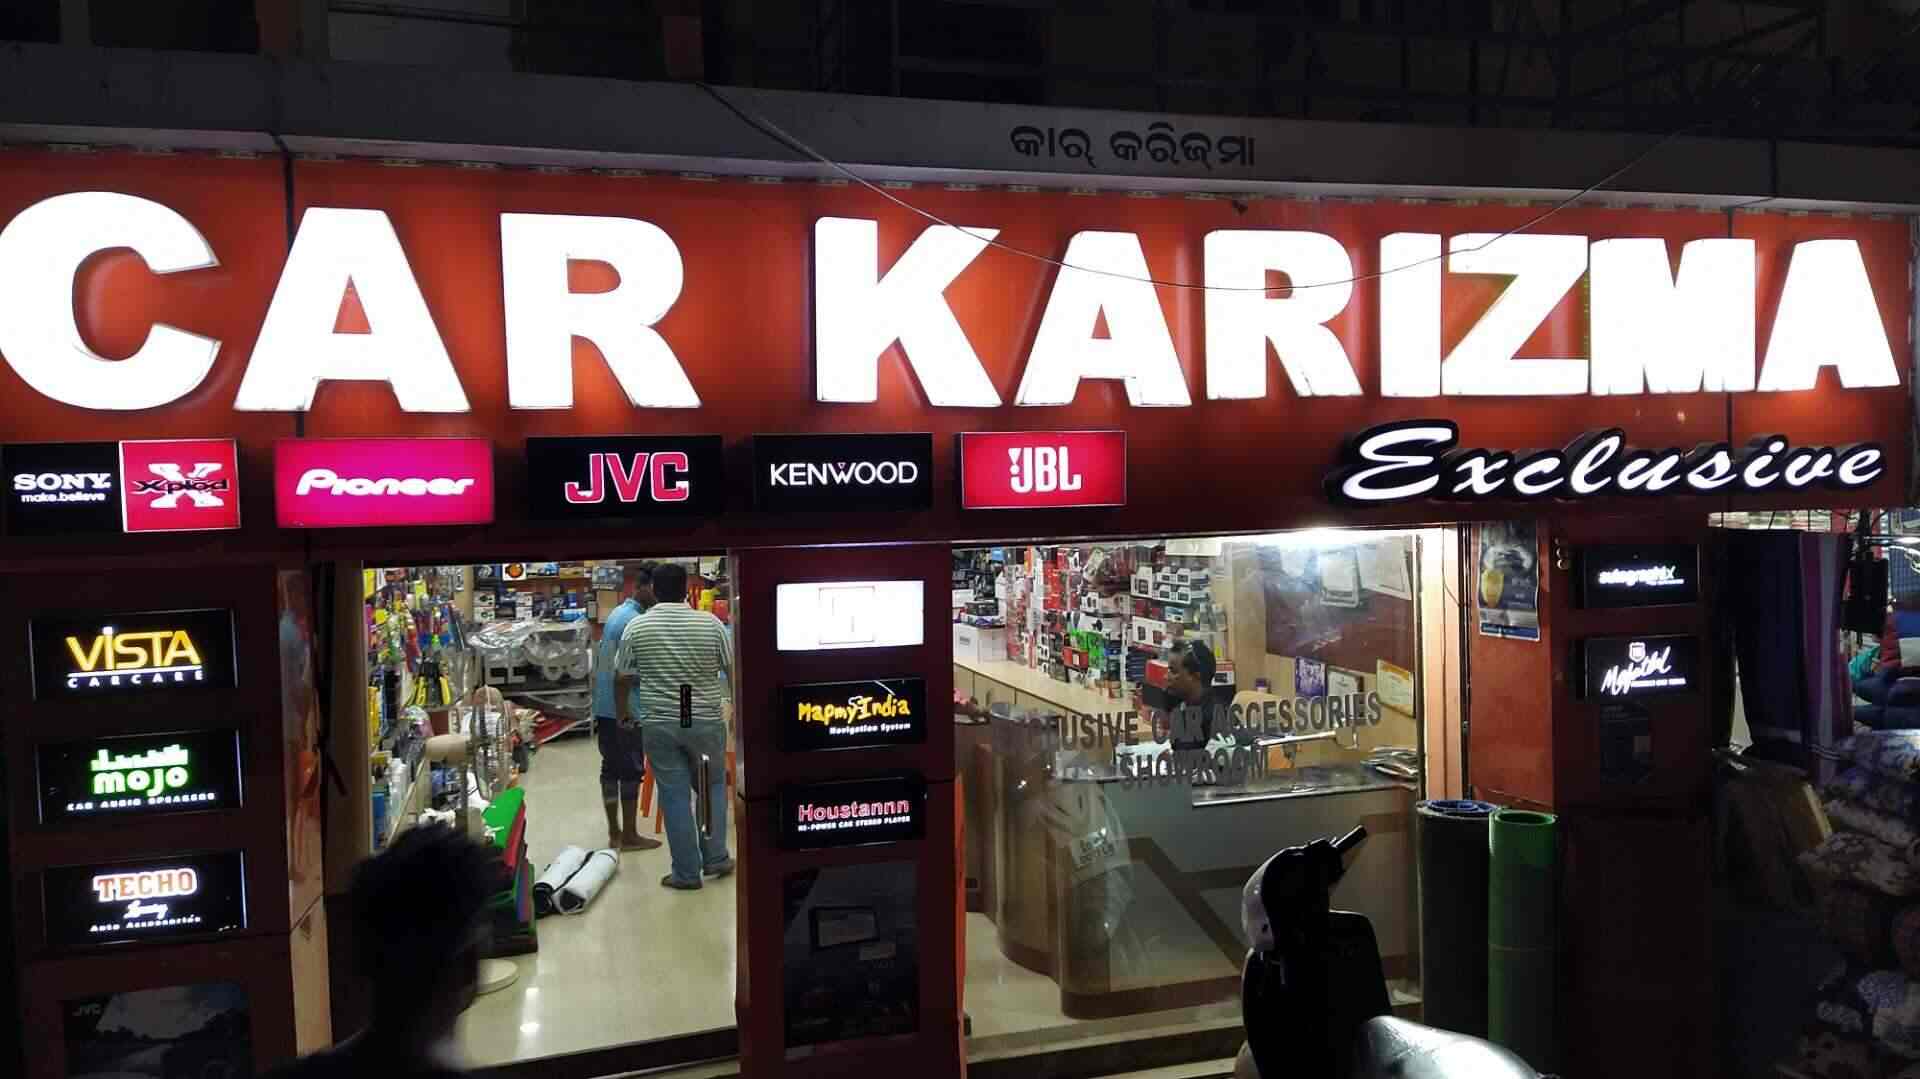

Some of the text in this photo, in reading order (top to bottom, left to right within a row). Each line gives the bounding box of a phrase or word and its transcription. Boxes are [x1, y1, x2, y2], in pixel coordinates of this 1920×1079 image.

[0, 191, 1901, 412] CAR KARIZMA
[14, 472, 112, 490] SONY
[295, 468, 476, 496] Pioneer
[564, 452, 689, 503] JVC
[770, 460, 919, 486] KENWOOD
[1008, 446, 1082, 493] JBL
[1342, 427, 1883, 500] Exclusive
[94, 869, 197, 901] TECHO
